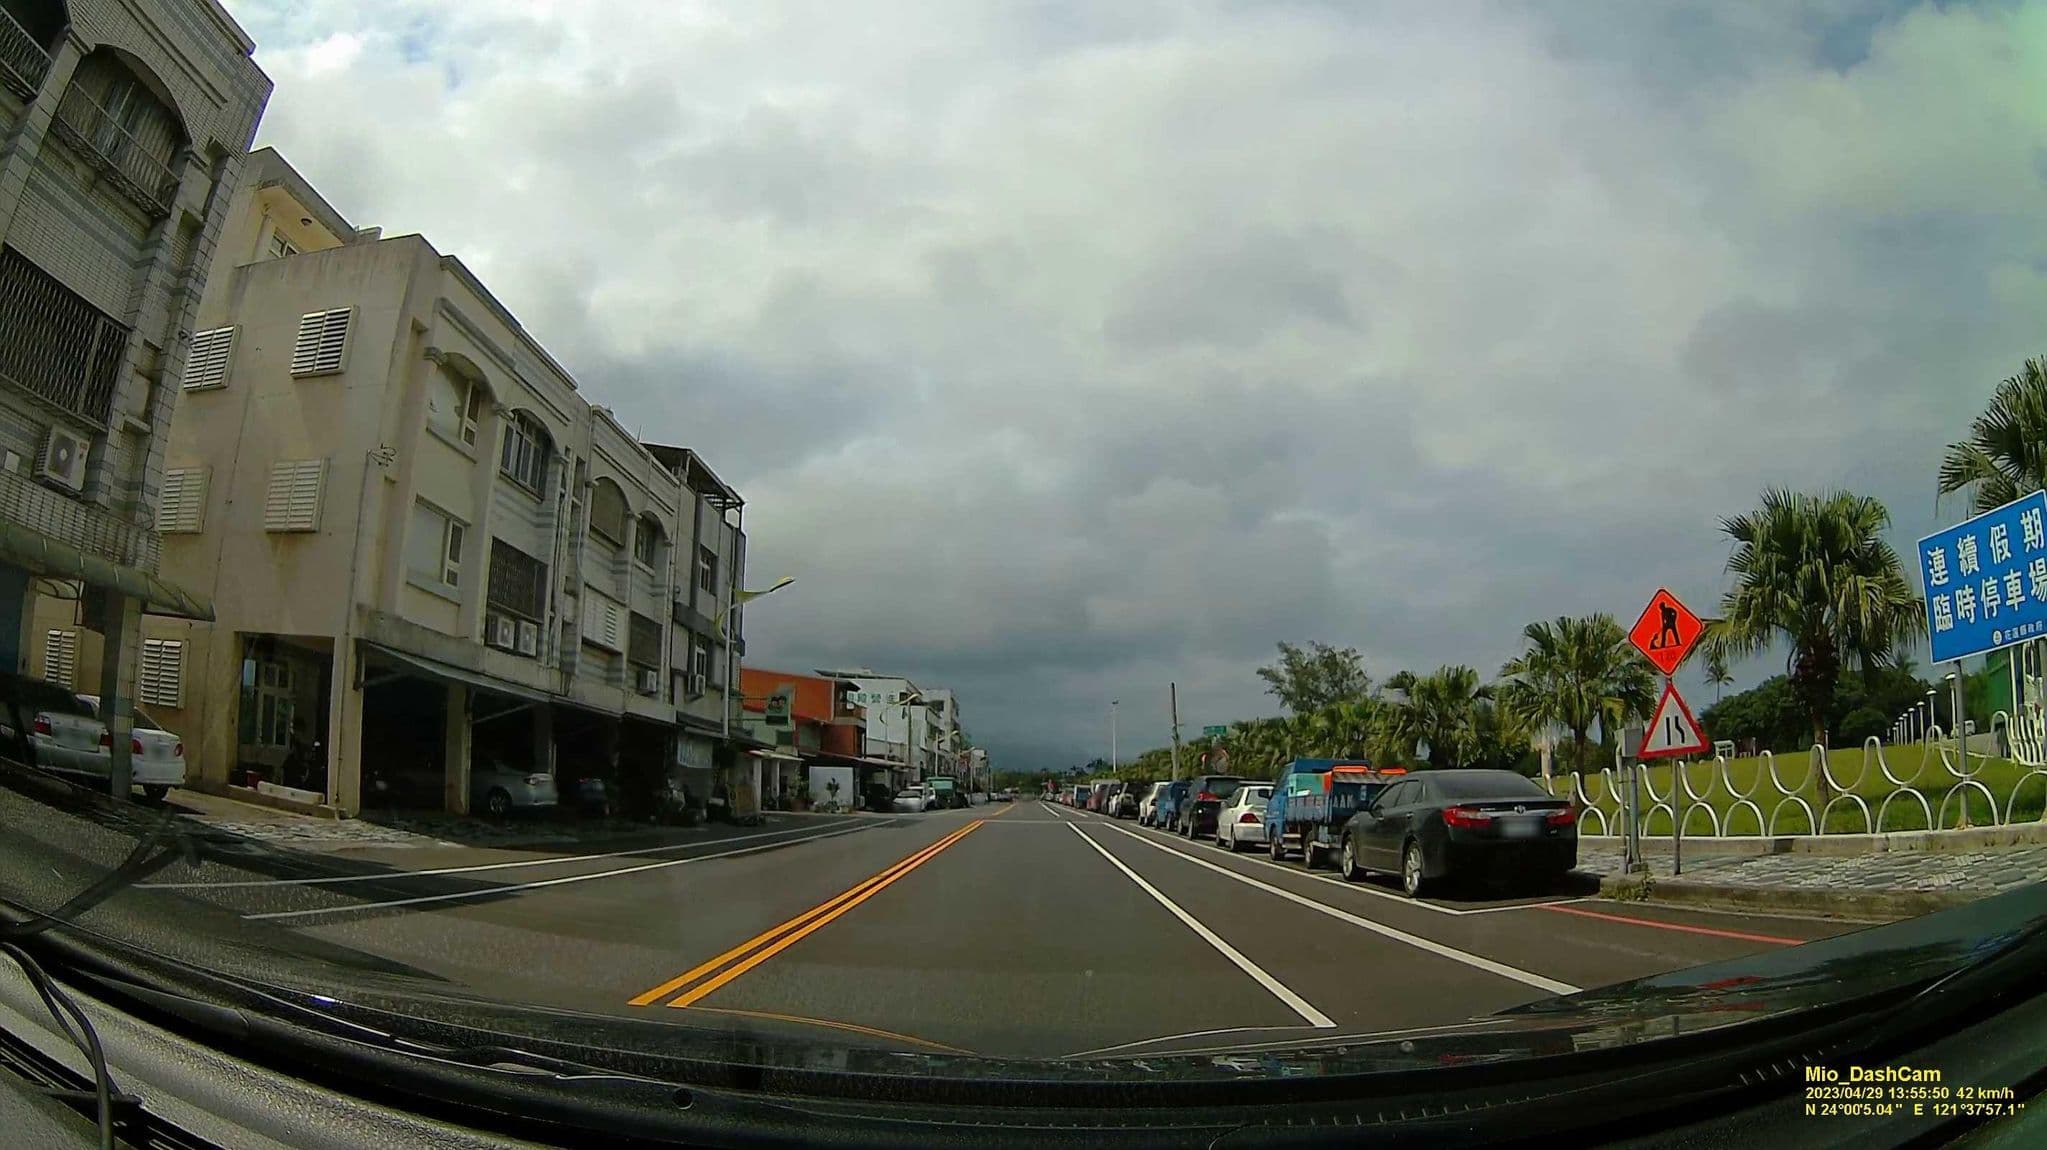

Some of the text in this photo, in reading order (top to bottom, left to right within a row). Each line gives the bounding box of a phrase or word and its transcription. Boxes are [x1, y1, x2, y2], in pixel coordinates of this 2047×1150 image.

[1928, 508, 2045, 587] 連續假期
[1933, 557, 2047, 632] 臨時停車場
